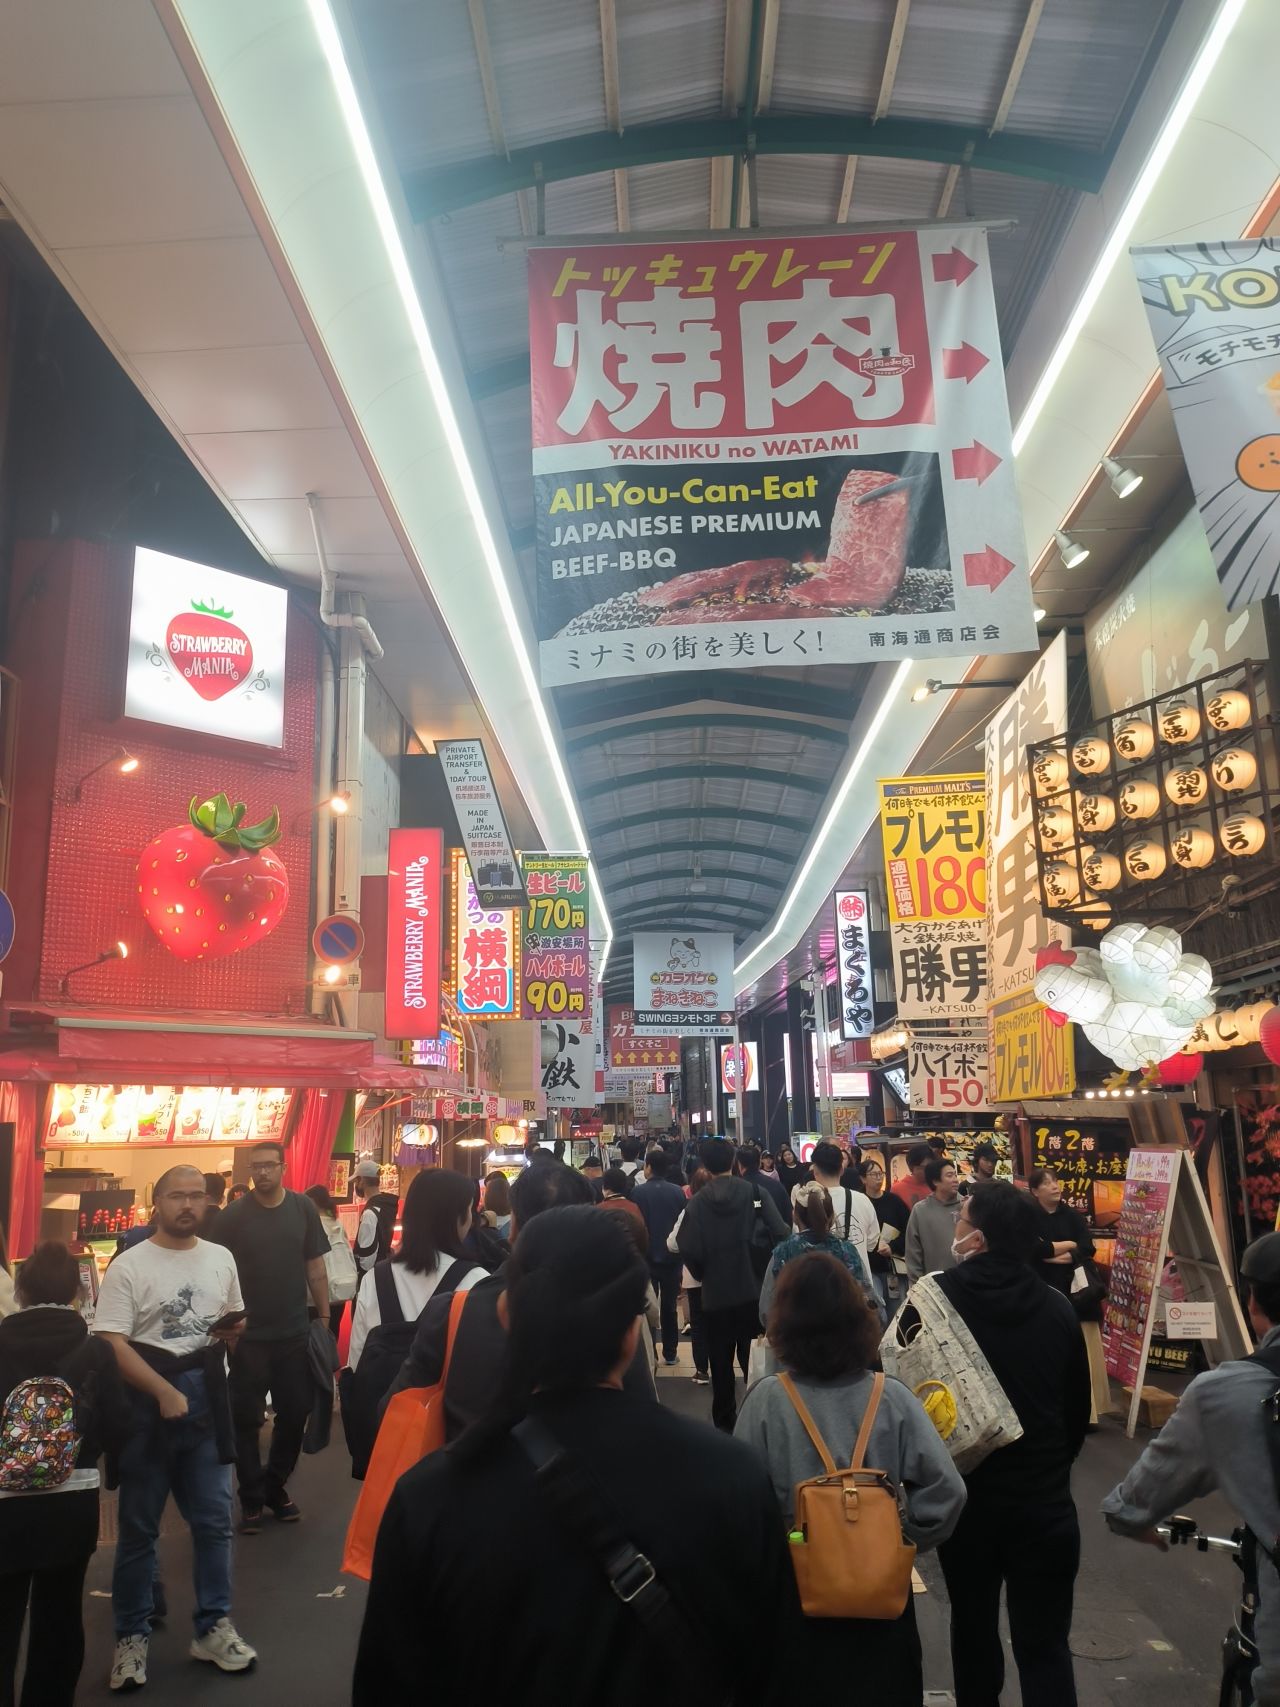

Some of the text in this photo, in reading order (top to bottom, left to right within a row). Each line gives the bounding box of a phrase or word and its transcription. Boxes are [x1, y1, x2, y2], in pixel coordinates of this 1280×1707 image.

[552, 241, 896, 297] トッキュウレーン
[1161, 267, 1280, 316] KO
[553, 279, 905, 436] 焼肉
[608, 434, 859, 460] YAKINIKU no WATAMI
[549, 476, 818, 514] All-You-Can-Eat
[551, 510, 821, 546] JAPANESE PREMIUM
[552, 547, 677, 580] BEEF-BBQ
[169, 633, 248, 656] STRAWBERRY
[869, 625, 1001, 647] 南海通商店会
[184, 657, 239, 680] MANIA
[909, 785, 943, 795] PREMIUM
[405, 856, 429, 917] MANIA
[527, 871, 586, 895] 生ビール
[888, 858, 918, 917] 適正価格
[894, 919, 986, 934] 大分からあげ
[902, 931, 980, 944] と鉄板焼
[541, 936, 584, 949] 激安場所
[404, 918, 427, 1010] STRAWBERRY
[462, 927, 508, 1010] 横綱
[525, 954, 586, 979] ハイボール
[660, 971, 708, 985] カラオケ
[526, 980, 584, 1014] 90円
[650, 987, 718, 1009] まねきねこ
[628, 1039, 662, 1049] すぐそこ
[910, 1052, 987, 1079] ハイボー
[926, 1078, 984, 1108] 150
[1165, 1348, 1189, 1362] BEEF
